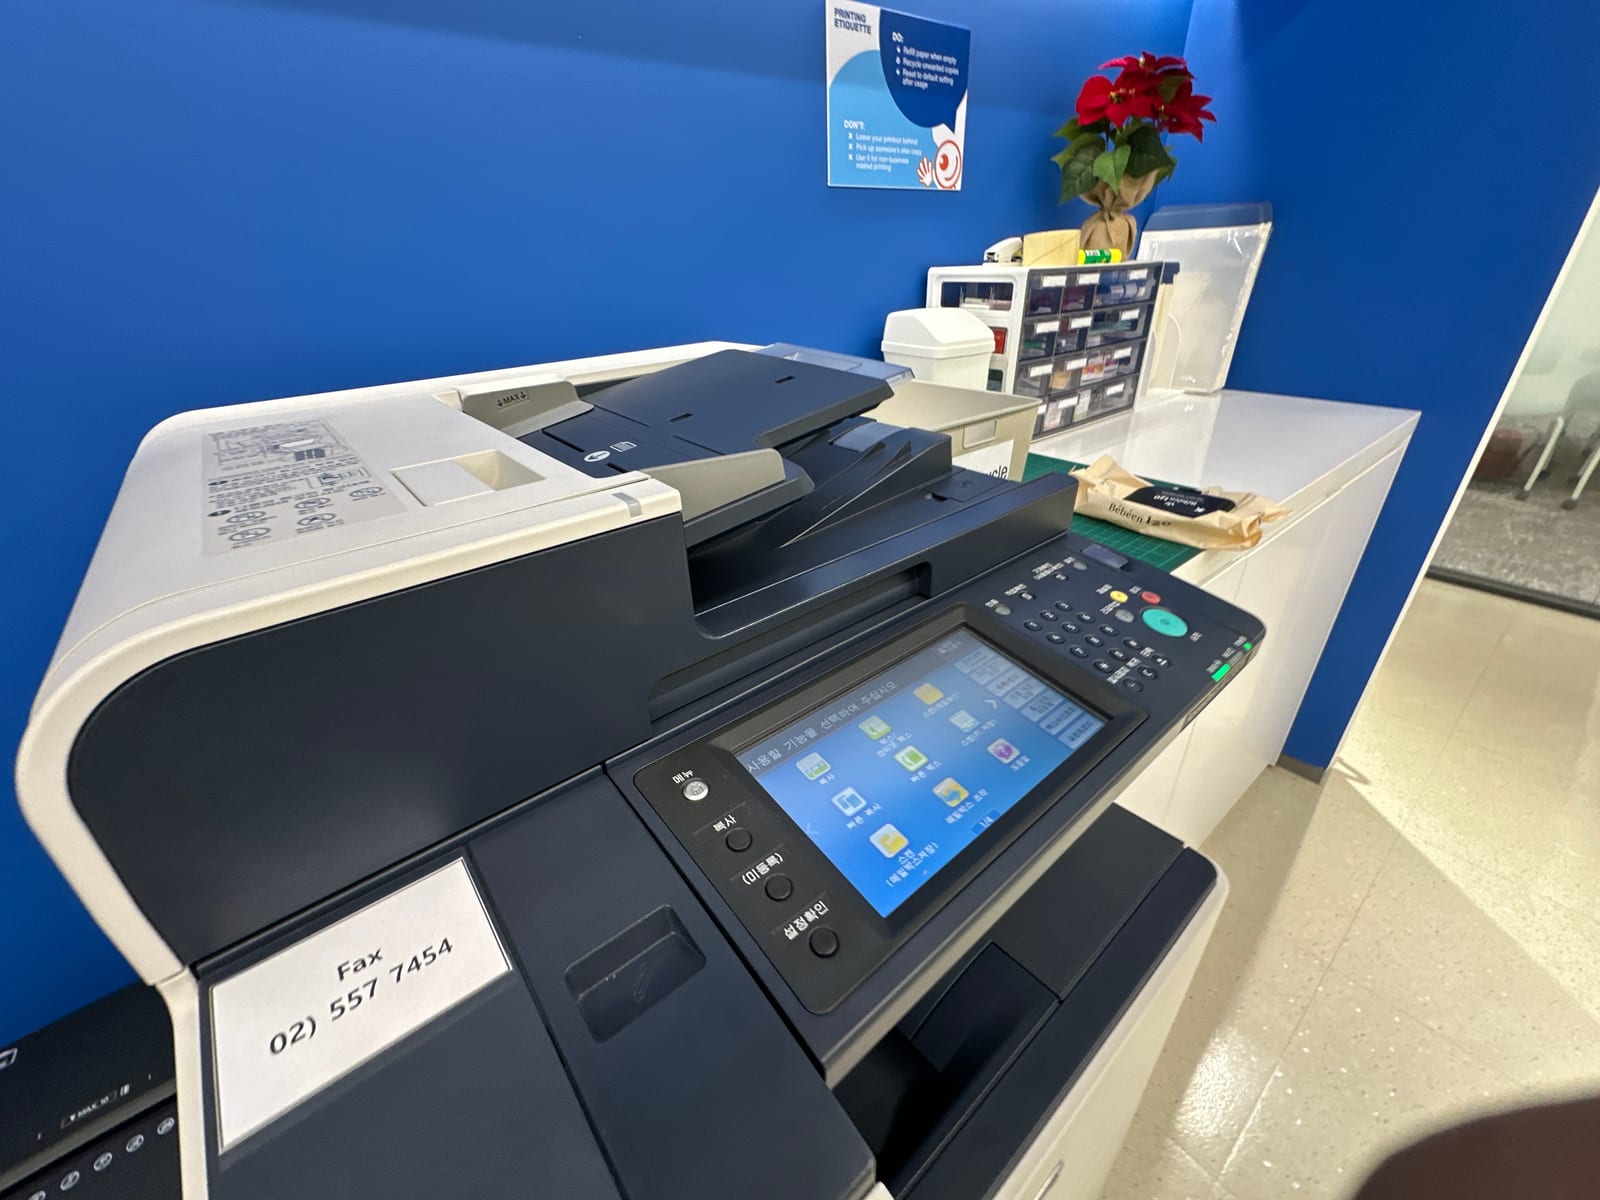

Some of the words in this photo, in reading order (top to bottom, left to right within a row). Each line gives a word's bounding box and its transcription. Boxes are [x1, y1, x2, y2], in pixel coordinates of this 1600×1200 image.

[834, 7, 867, 23] PRINTING
[834, 18, 872, 34] ETIQUETTE
[892, 31, 904, 43] DO:
[902, 57, 921, 69] Recycle
[922, 62, 944, 73] unwanted
[856, 133, 871, 142] Leave
[856, 142, 866, 152] Pick
[856, 153, 866, 162] Use
[503, 392, 520, 404] MAX
[747, 748, 782, 773] 사용할
[783, 727, 818, 751] 기능을
[820, 703, 861, 730] 선택하여
[861, 681, 898, 705] 주십시오
[672, 769, 694, 784] 메뉴
[713, 814, 737, 832] 복사
[742, 853, 784, 885] (미등록)
[783, 900, 829, 940] 설정확인
[337, 948, 383, 981] Fax
[269, 1015, 317, 1055] 02)
[330, 978, 377, 1021] 557
[389, 938, 453, 983] 7454
